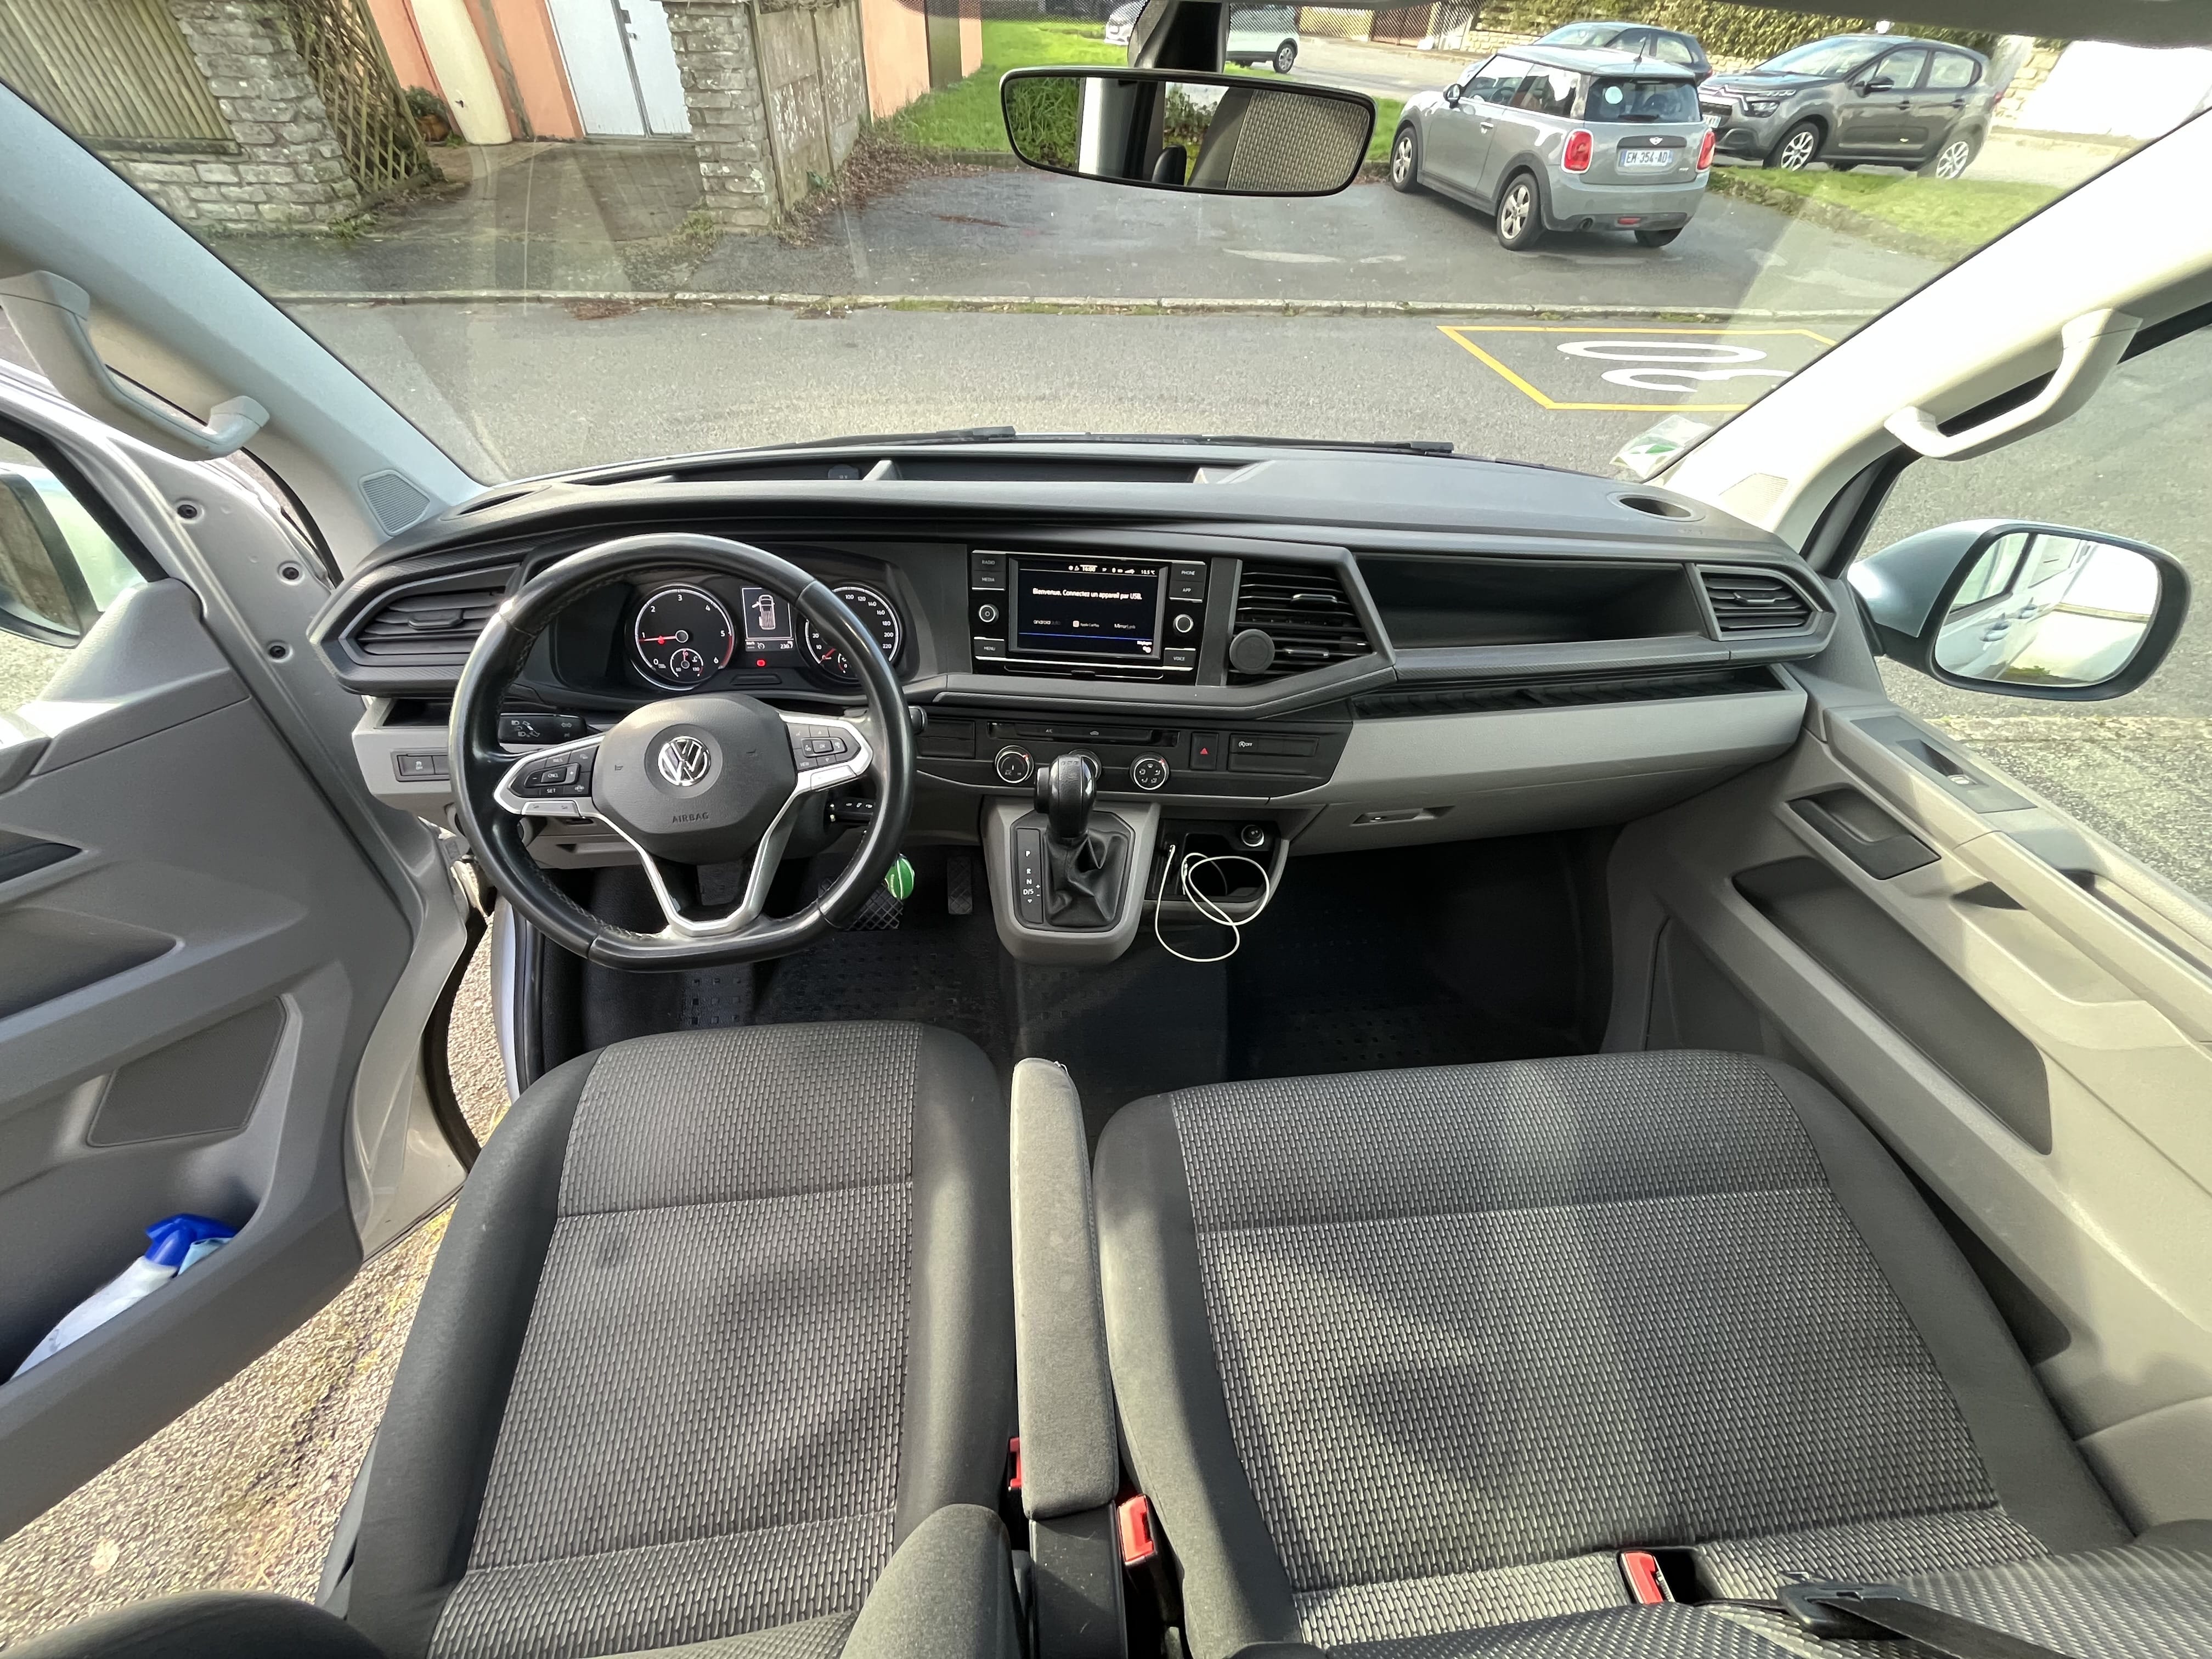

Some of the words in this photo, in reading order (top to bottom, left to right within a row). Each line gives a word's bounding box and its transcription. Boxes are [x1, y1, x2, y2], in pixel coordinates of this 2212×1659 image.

[1626, 151, 1668, 163] EM-354-AD
[1032, 588, 1062, 596] Bienvenue.
[1063, 589, 1090, 597] Connectez
[672, 812, 709, 823] AIRBAG
